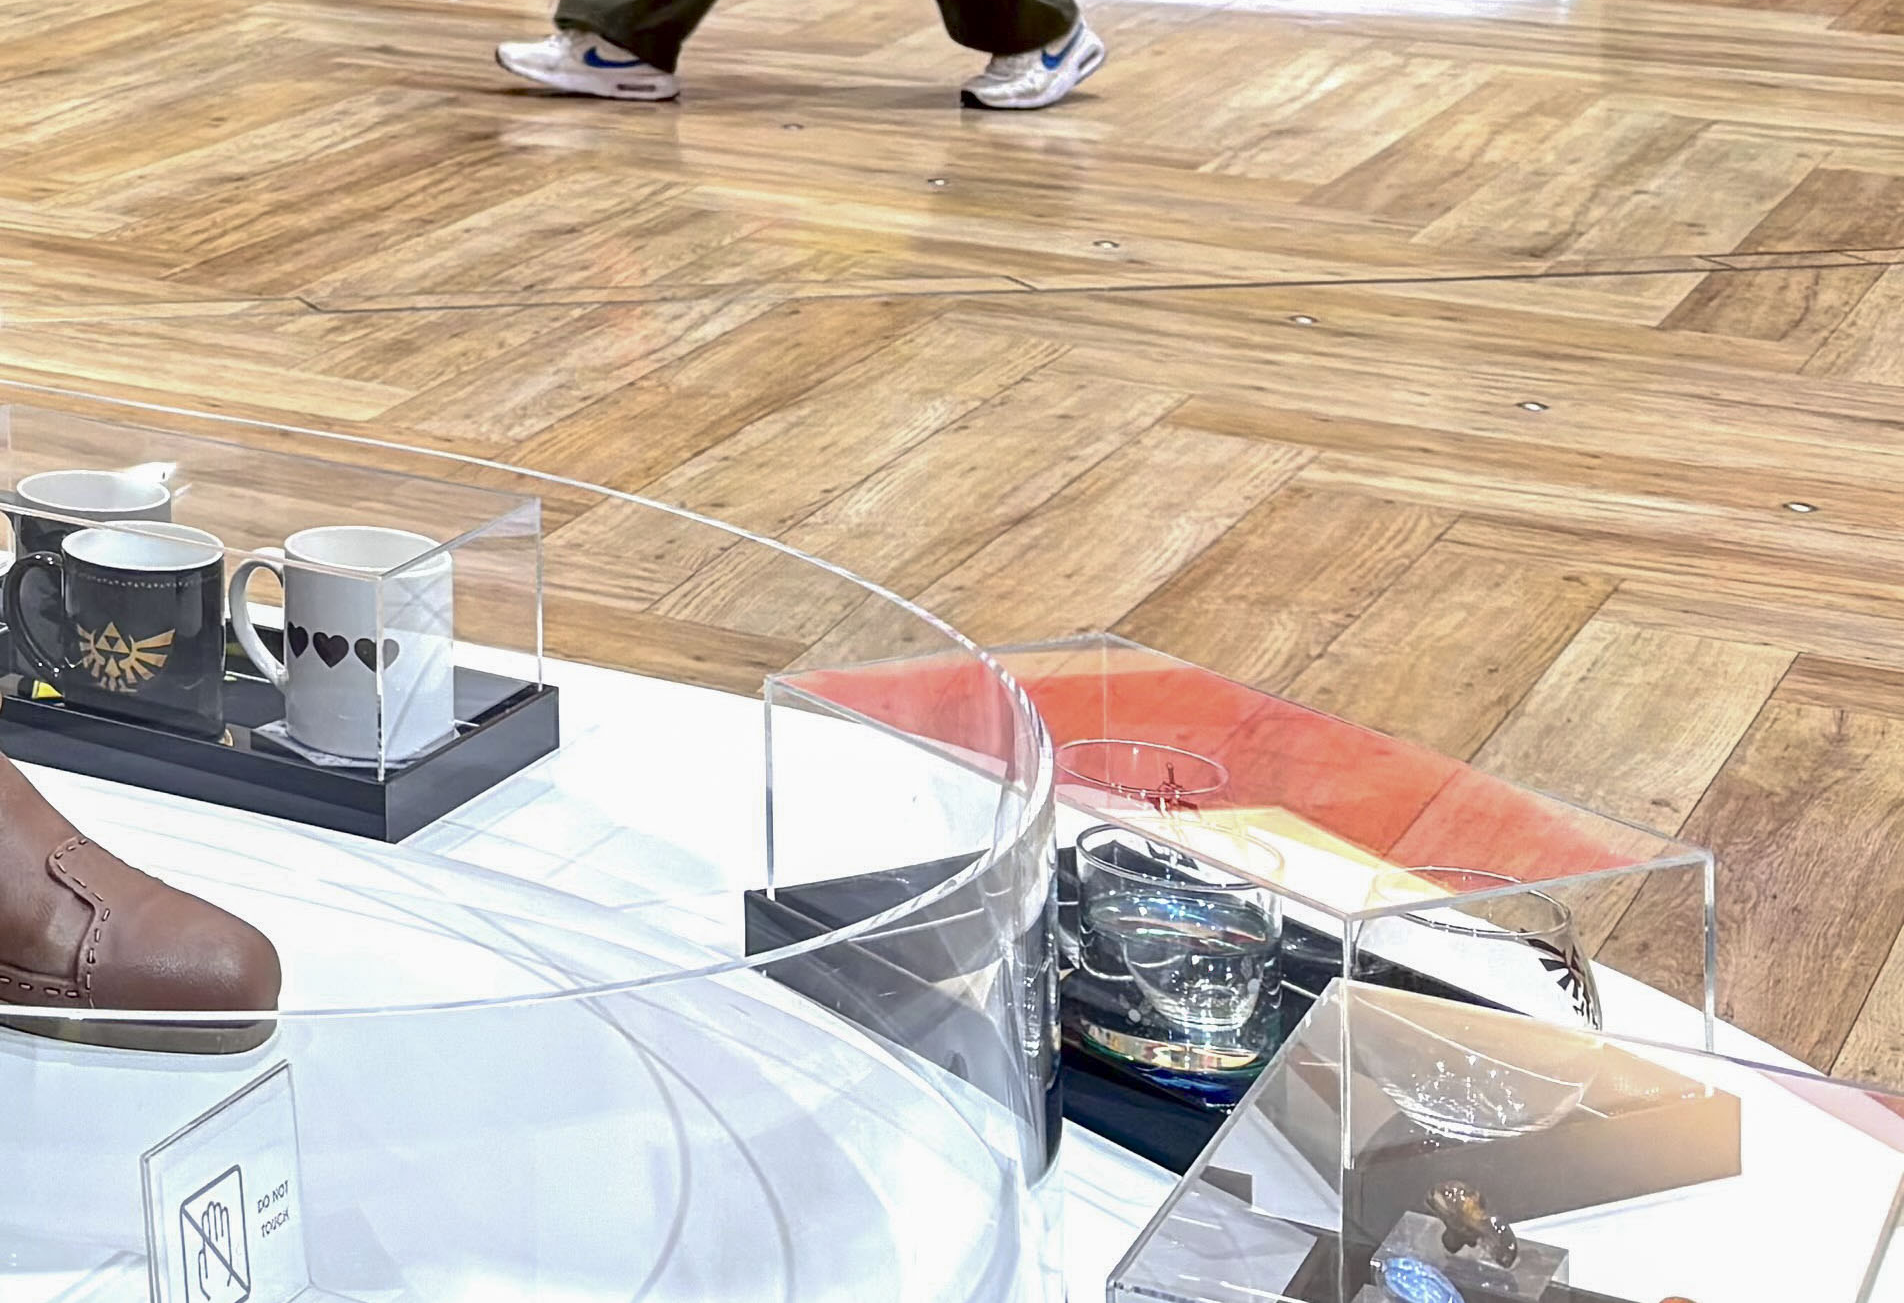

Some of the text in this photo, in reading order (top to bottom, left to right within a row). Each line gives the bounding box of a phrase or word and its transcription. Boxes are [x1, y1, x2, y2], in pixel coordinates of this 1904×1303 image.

[257, 1179, 289, 1214] DO NOT
[260, 1206, 290, 1238] TOUCH
